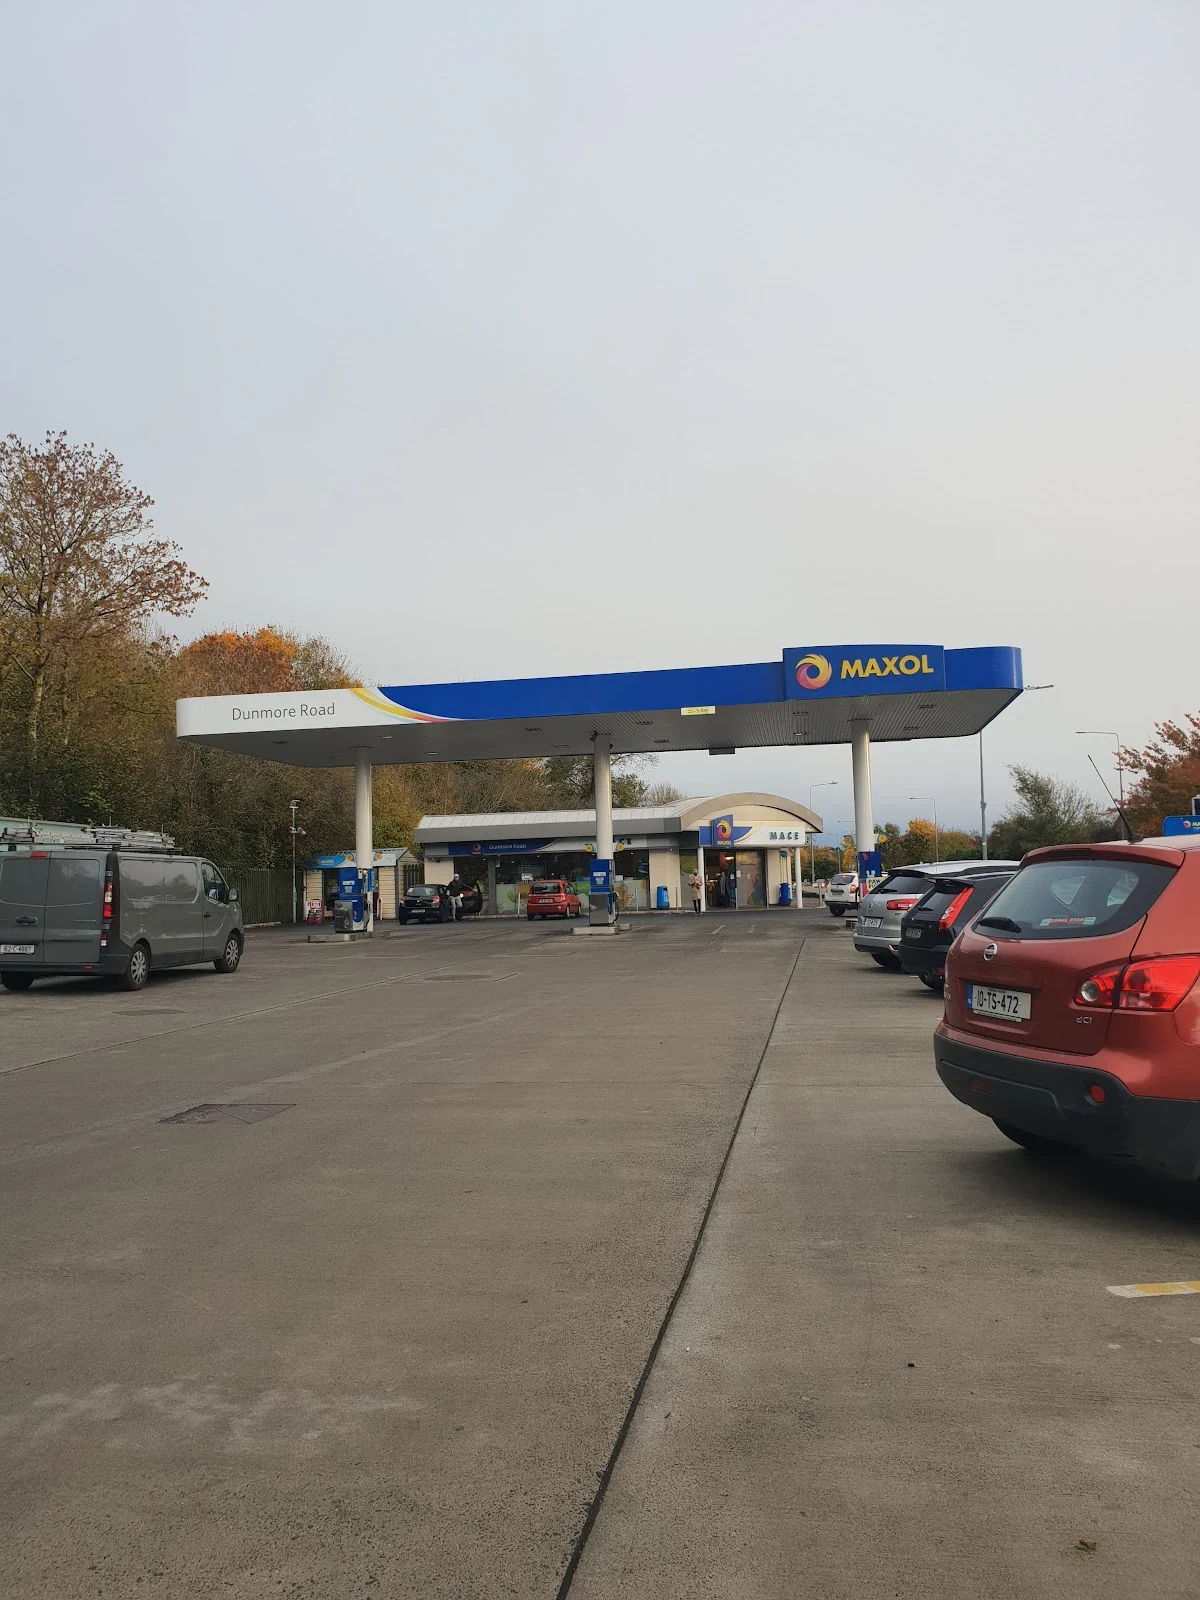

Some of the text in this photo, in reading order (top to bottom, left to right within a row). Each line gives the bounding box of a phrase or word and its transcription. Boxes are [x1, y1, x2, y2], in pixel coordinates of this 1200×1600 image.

[840, 654, 934, 679] MAXOL
[232, 702, 335, 721] Dunmore Road
[769, 831, 799, 840] MACE
[976, 989, 1019, 1014] 10-TS-472
